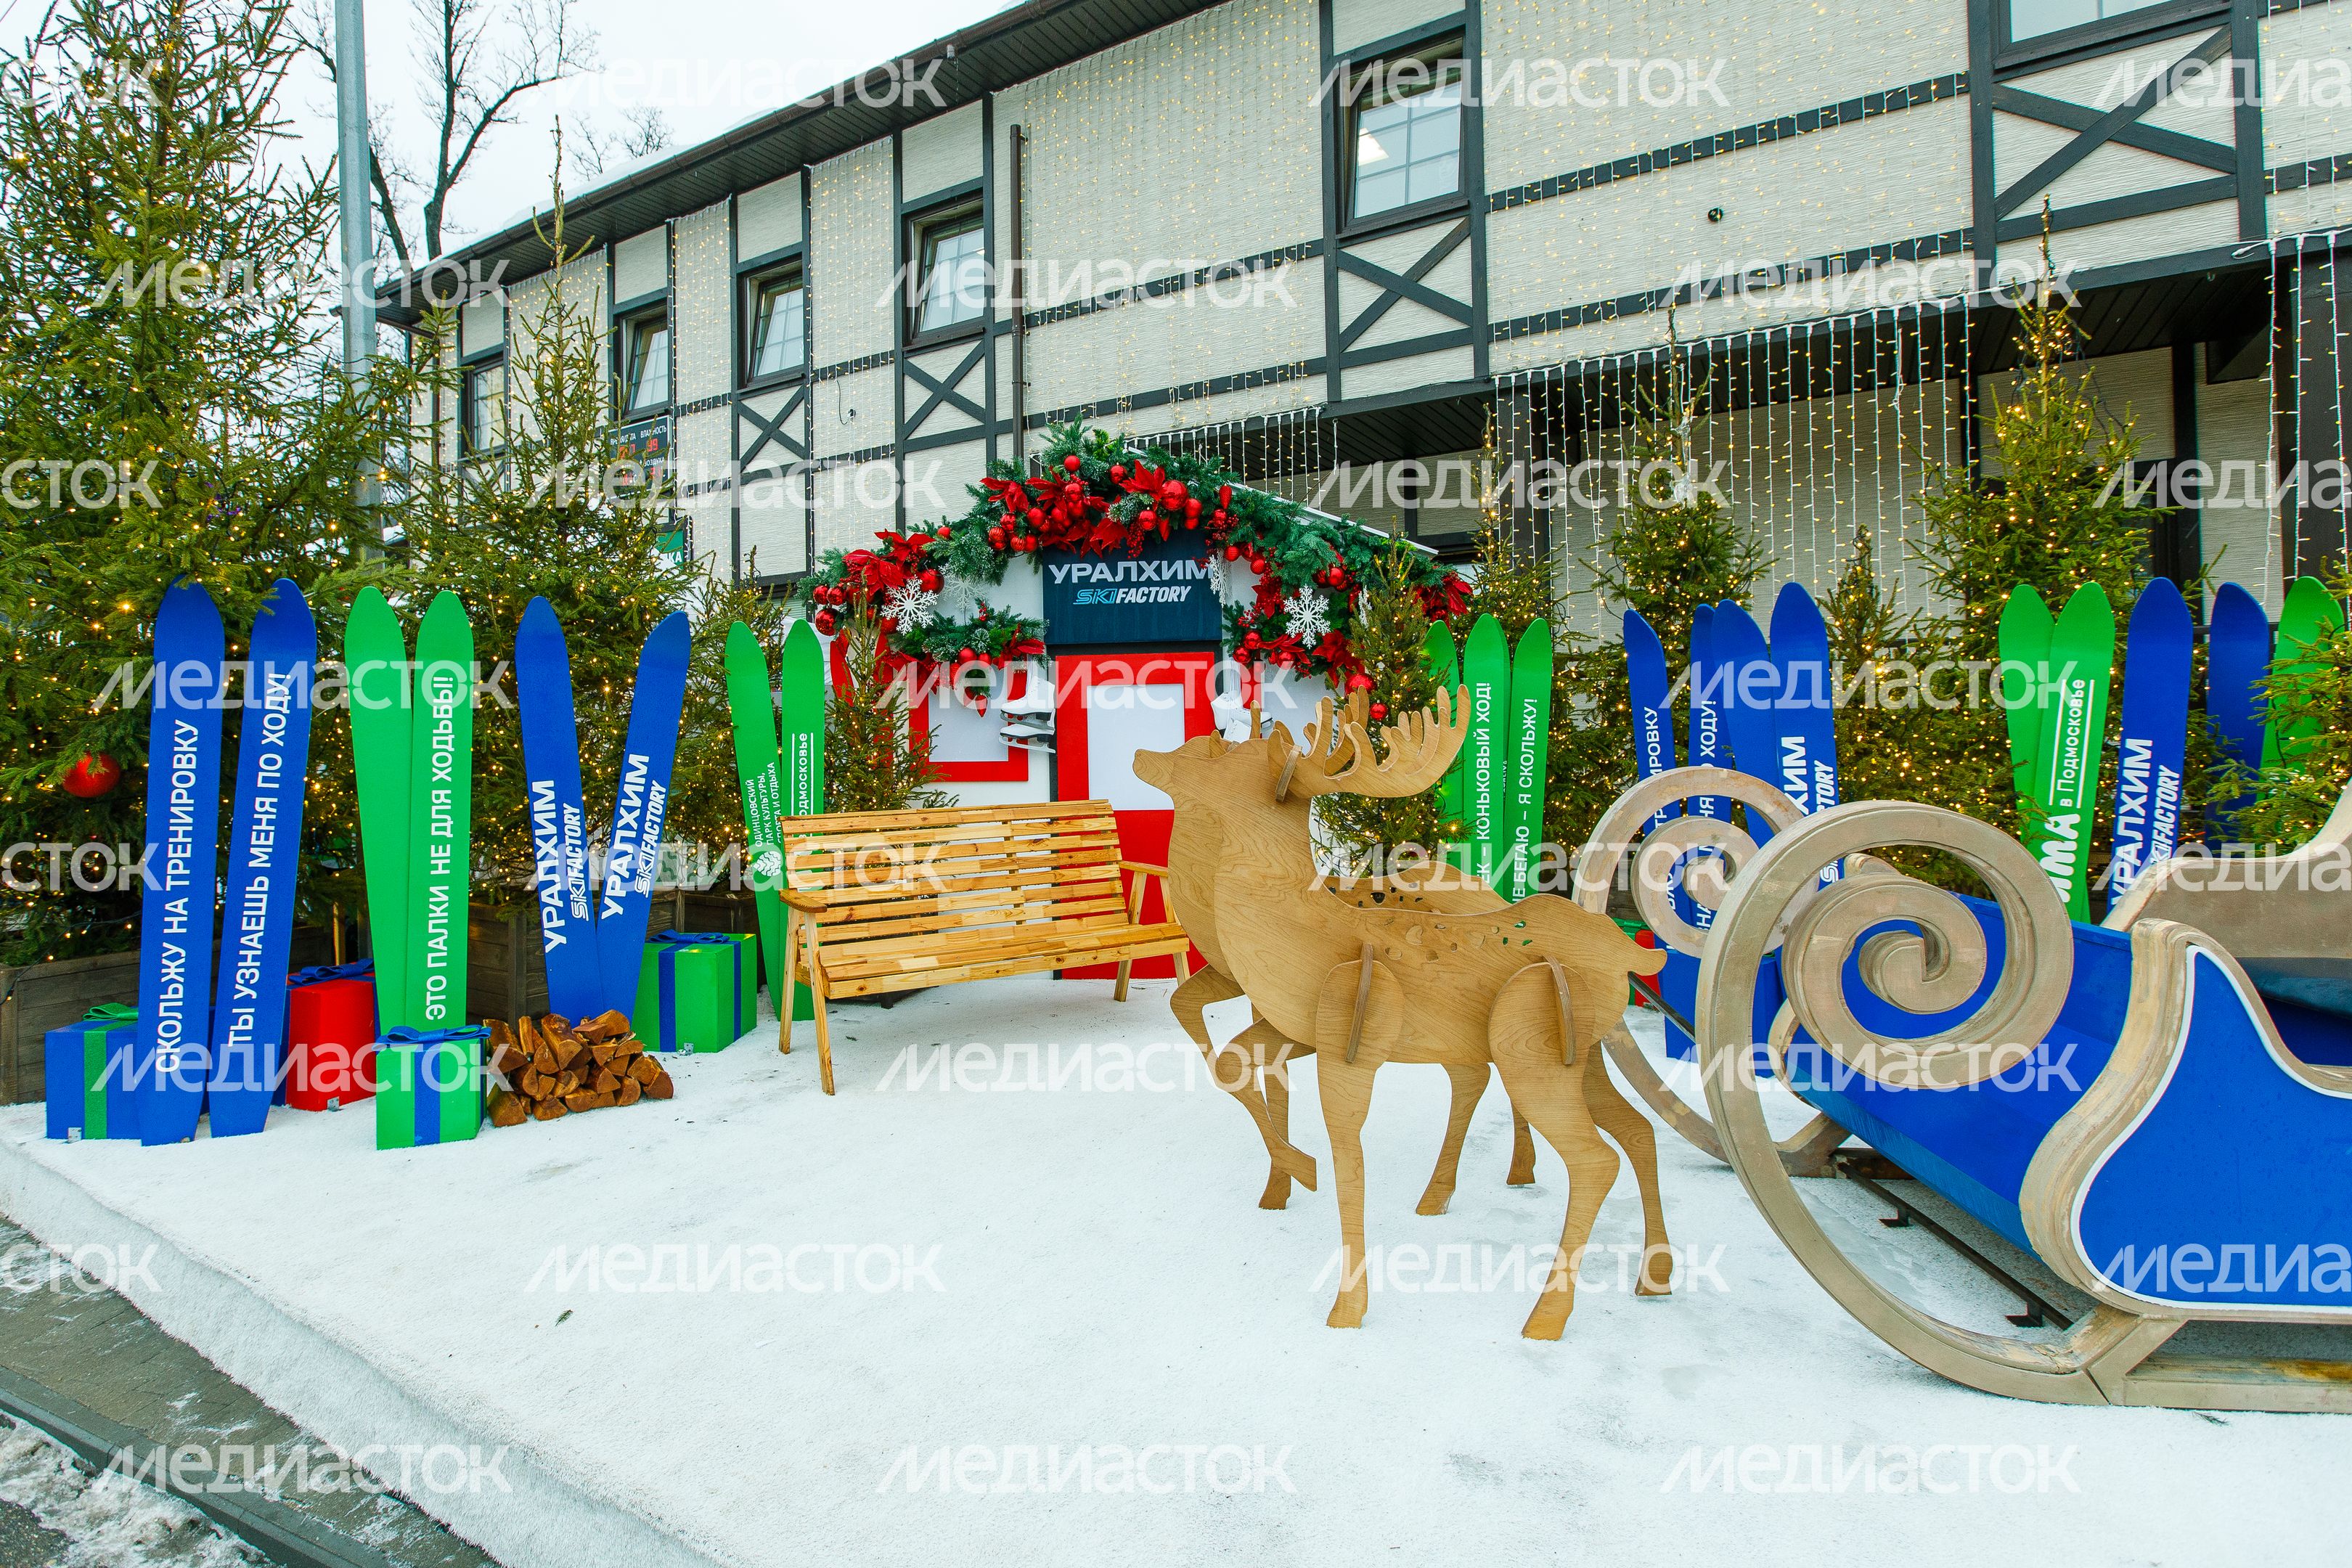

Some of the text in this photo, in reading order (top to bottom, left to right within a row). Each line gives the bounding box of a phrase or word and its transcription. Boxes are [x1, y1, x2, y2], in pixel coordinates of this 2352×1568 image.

[1048, 560, 1214, 584] УРАЛХИМ
[1476, 682, 1491, 722] ХОД!
[1700, 701, 1718, 758] ХОДУ!
[767, 761, 779, 799] ОТДЫХА
[799, 732, 809, 816] одмосковье
[1519, 698, 1538, 788] СКОЛЬЖУ!
[745, 779, 764, 847] ОДИНЦОВСКИЙ
[757, 773, 774, 845] ПАРК КУЛЬТУРЫ,
[1473, 728, 1490, 840] КОНЬКОВЫЙ
[1518, 793, 1532, 804] Я
[228, 674, 291, 1047] ТЫ УЗНАЕШЬ МЕНЯ ПО ХОДУ!
[425, 677, 454, 1021] ЭТО ПАЛКИ НЕ ДЛЯ ХОДЬБЫ!
[532, 780, 567, 952] УРАЛХИМ
[601, 754, 650, 920] УРАЛХИМ
[1514, 825, 1530, 883] БЕГАЮ
[155, 719, 198, 1072] СКОЛЬЖУ НА ТРЕНИРОВКУ
